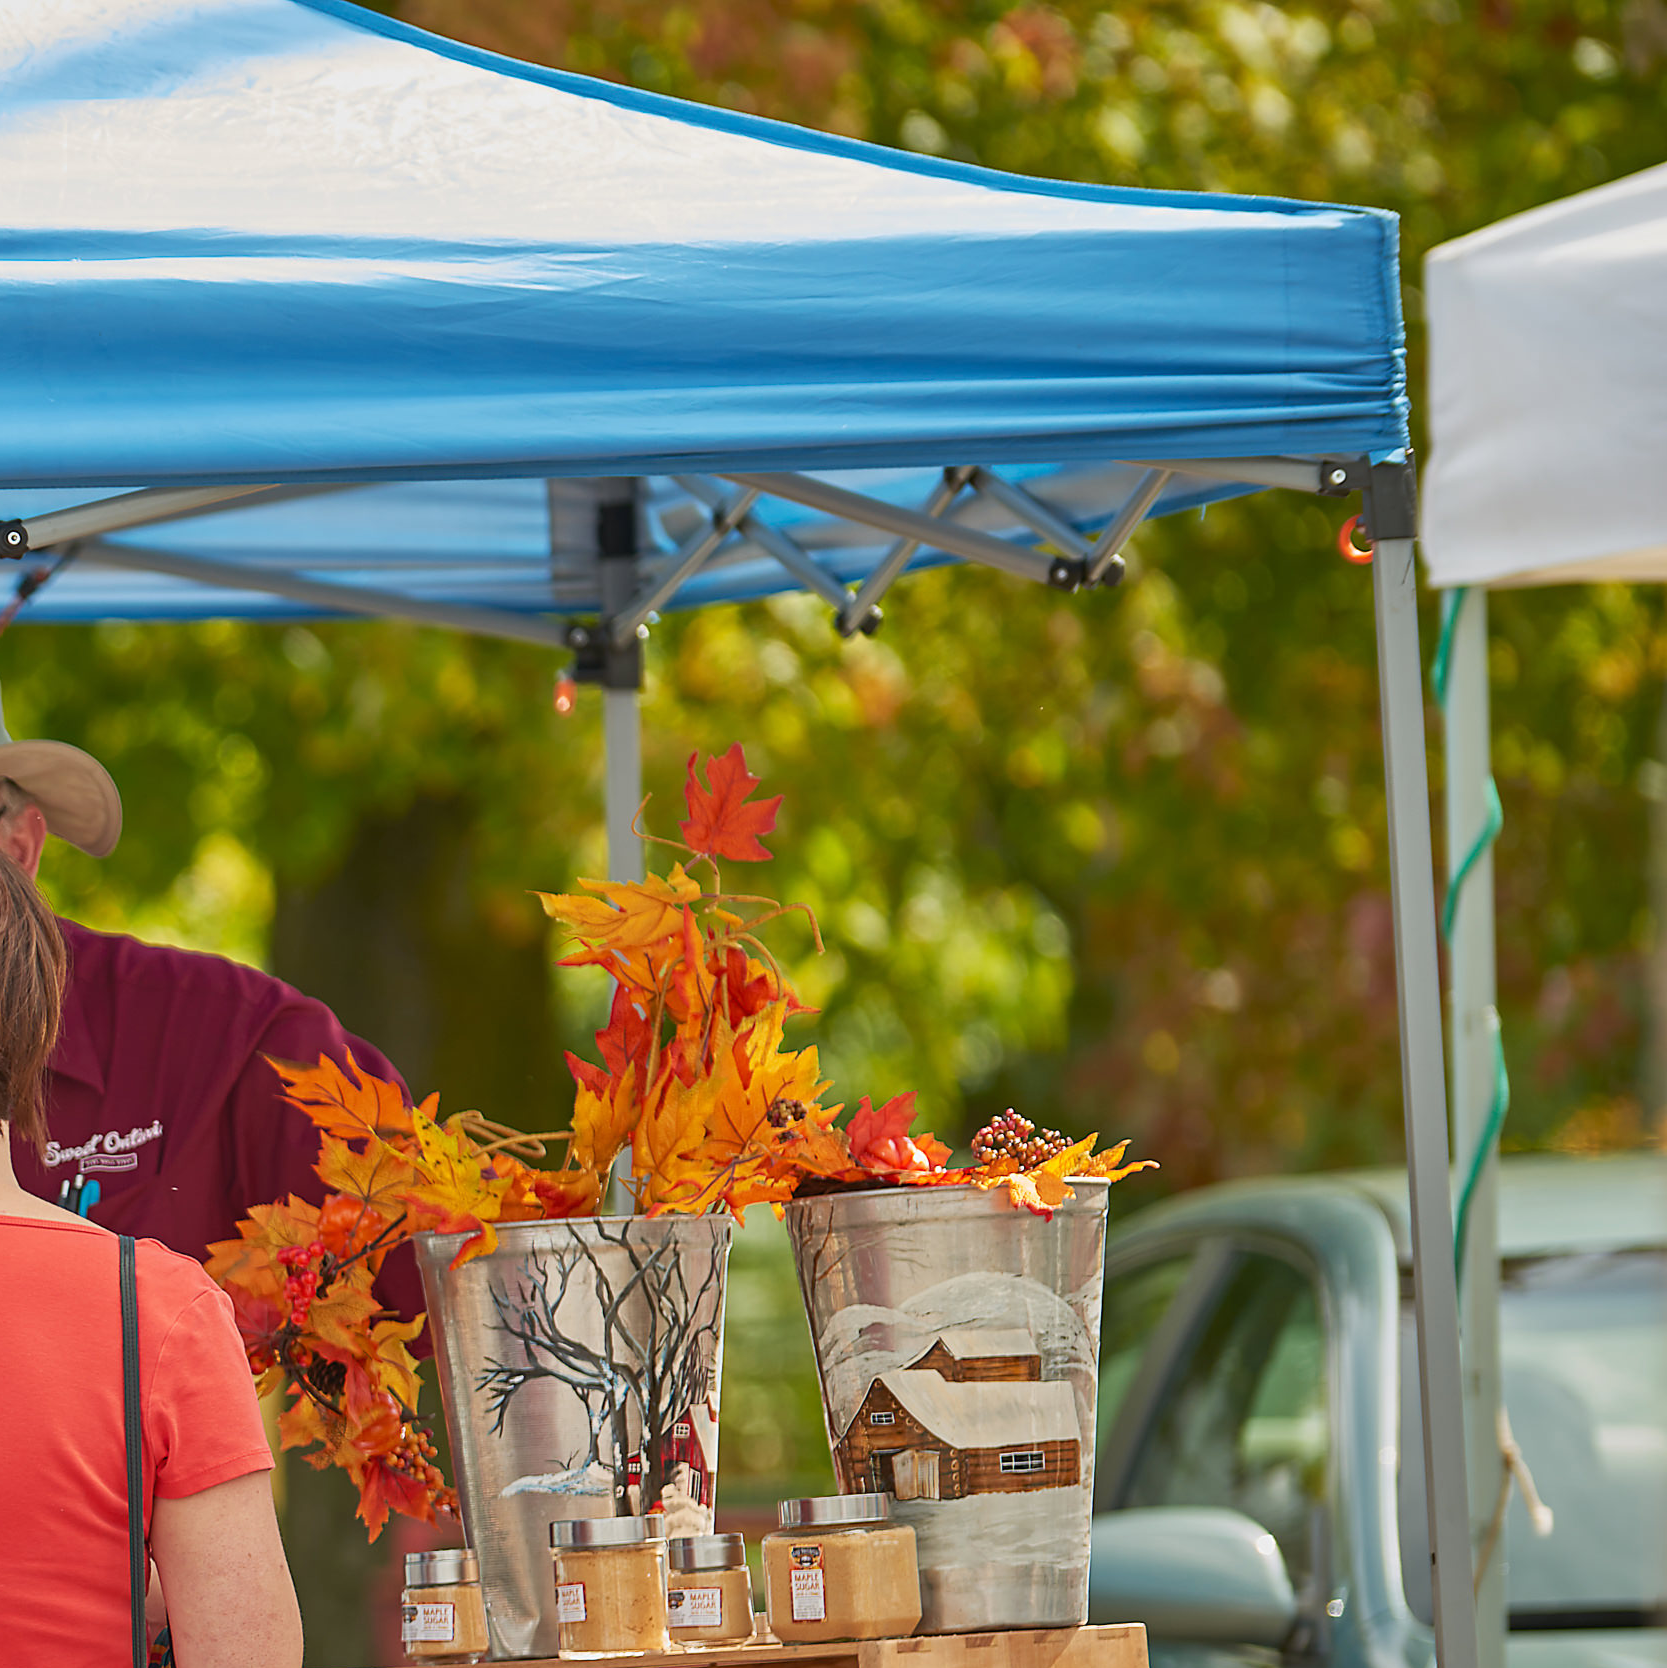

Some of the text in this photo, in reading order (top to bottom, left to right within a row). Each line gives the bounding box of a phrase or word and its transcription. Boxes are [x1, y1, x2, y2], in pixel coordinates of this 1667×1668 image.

[794, 1573, 818, 1581] MAPLE
[795, 1582, 820, 1591] SUGAR
[689, 1592, 716, 1601] MAPLE
[690, 1601, 717, 1610] SUGAR
[423, 1607, 450, 1616] MAPLE
[423, 1616, 450, 1625] SUGAR
